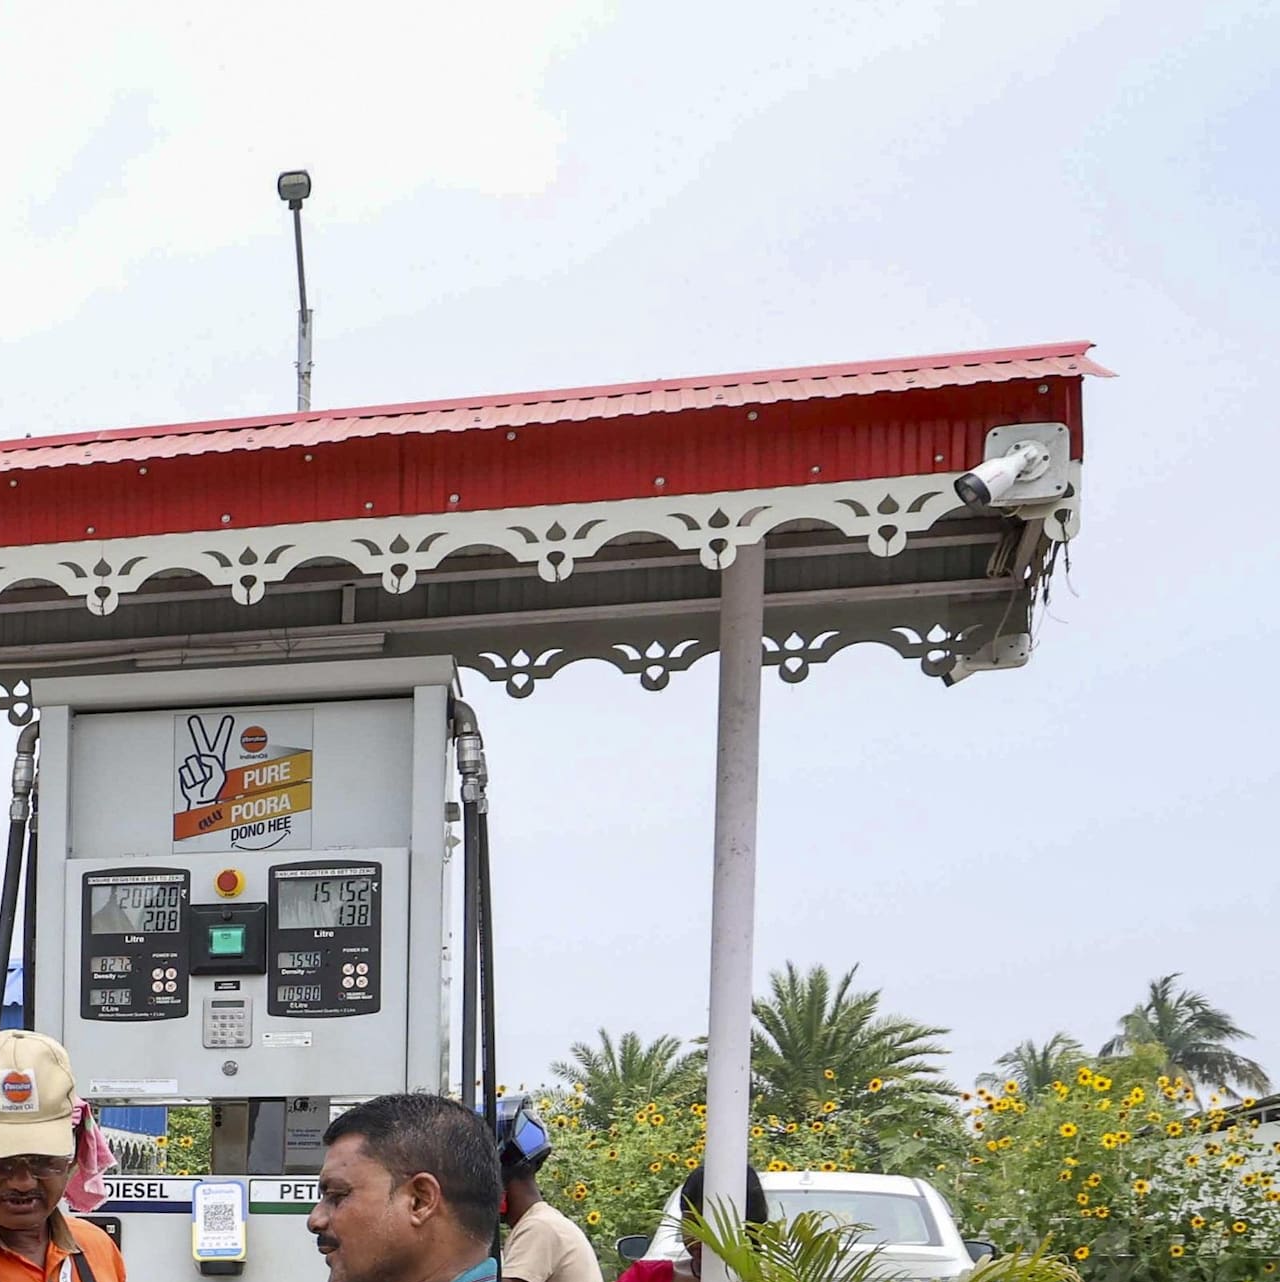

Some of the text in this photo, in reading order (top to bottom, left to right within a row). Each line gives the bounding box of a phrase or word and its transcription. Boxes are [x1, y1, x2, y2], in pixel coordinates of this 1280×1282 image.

[244, 762, 290, 788] PURE
[231, 793, 291, 823] POORA
[231, 816, 291, 841] DONO HEE
[314, 930, 334, 938] Litre
